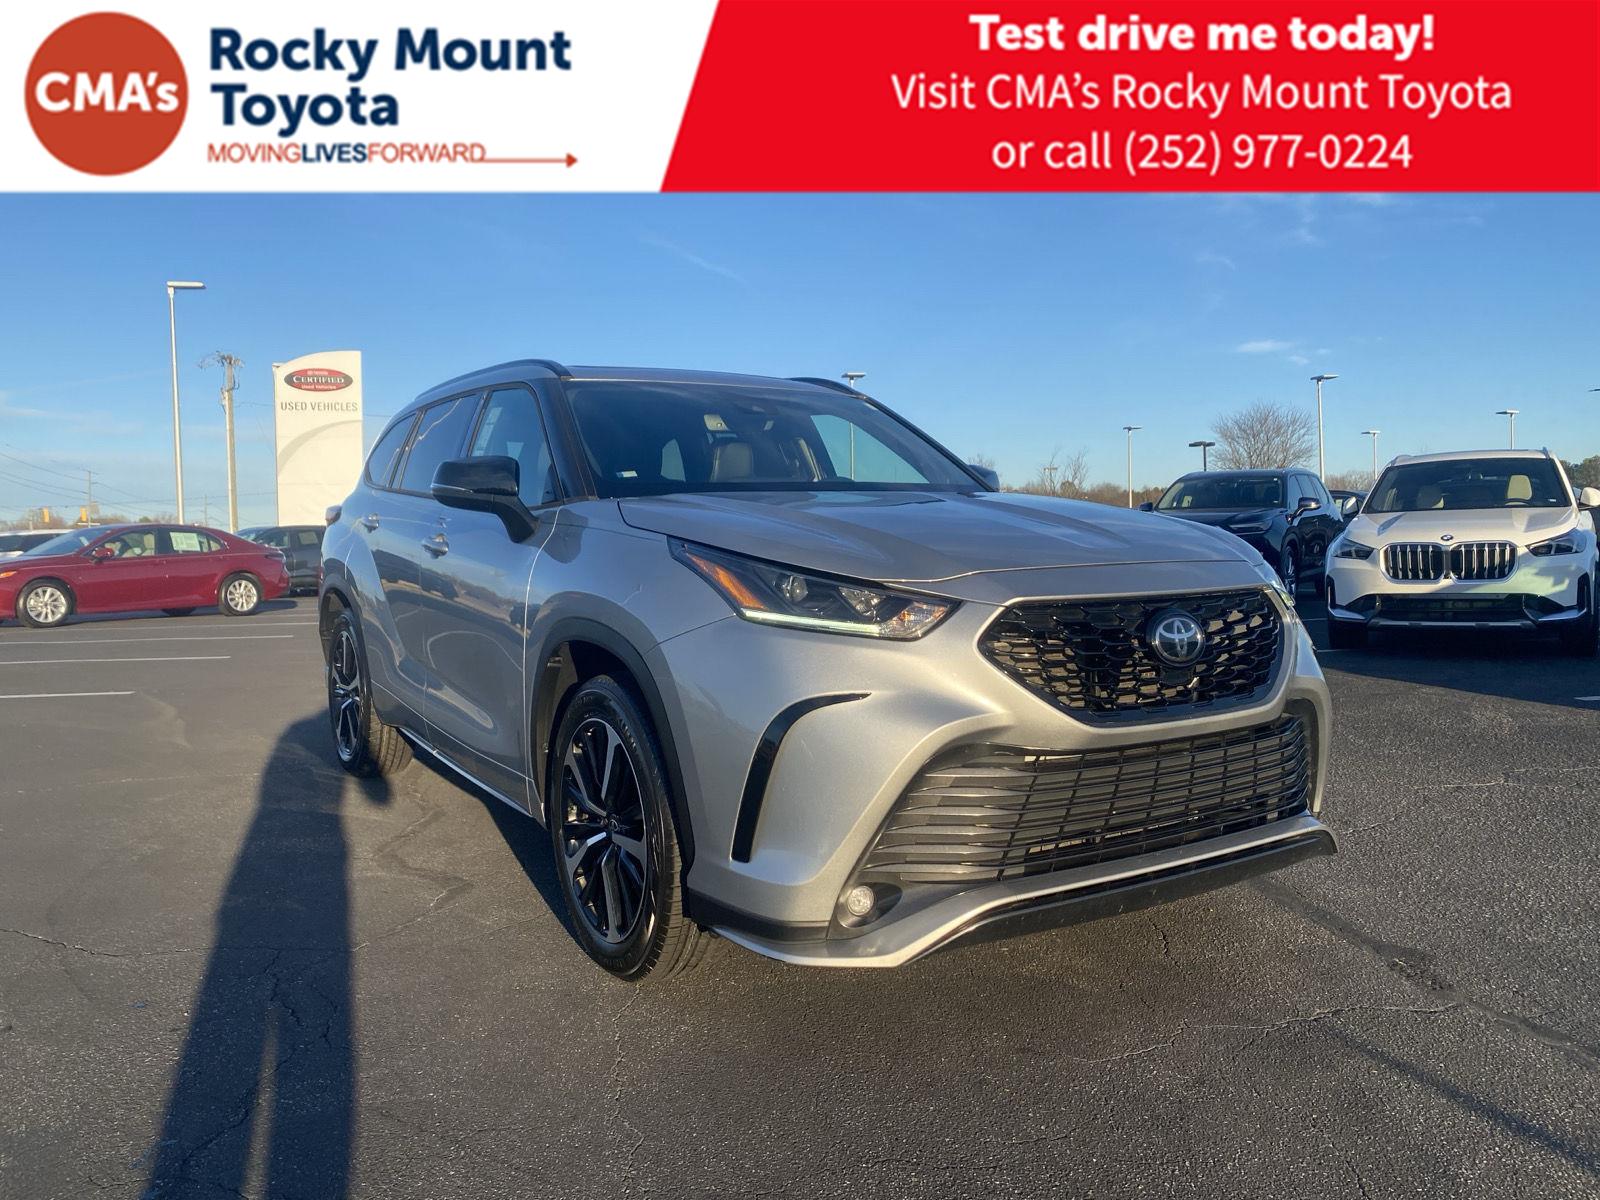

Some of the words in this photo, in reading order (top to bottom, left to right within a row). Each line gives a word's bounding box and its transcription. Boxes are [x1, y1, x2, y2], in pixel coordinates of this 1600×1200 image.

[293, 375, 345, 384] CERTIFIED
[280, 401, 307, 411] USED
[310, 401, 359, 412] VEHICLES
